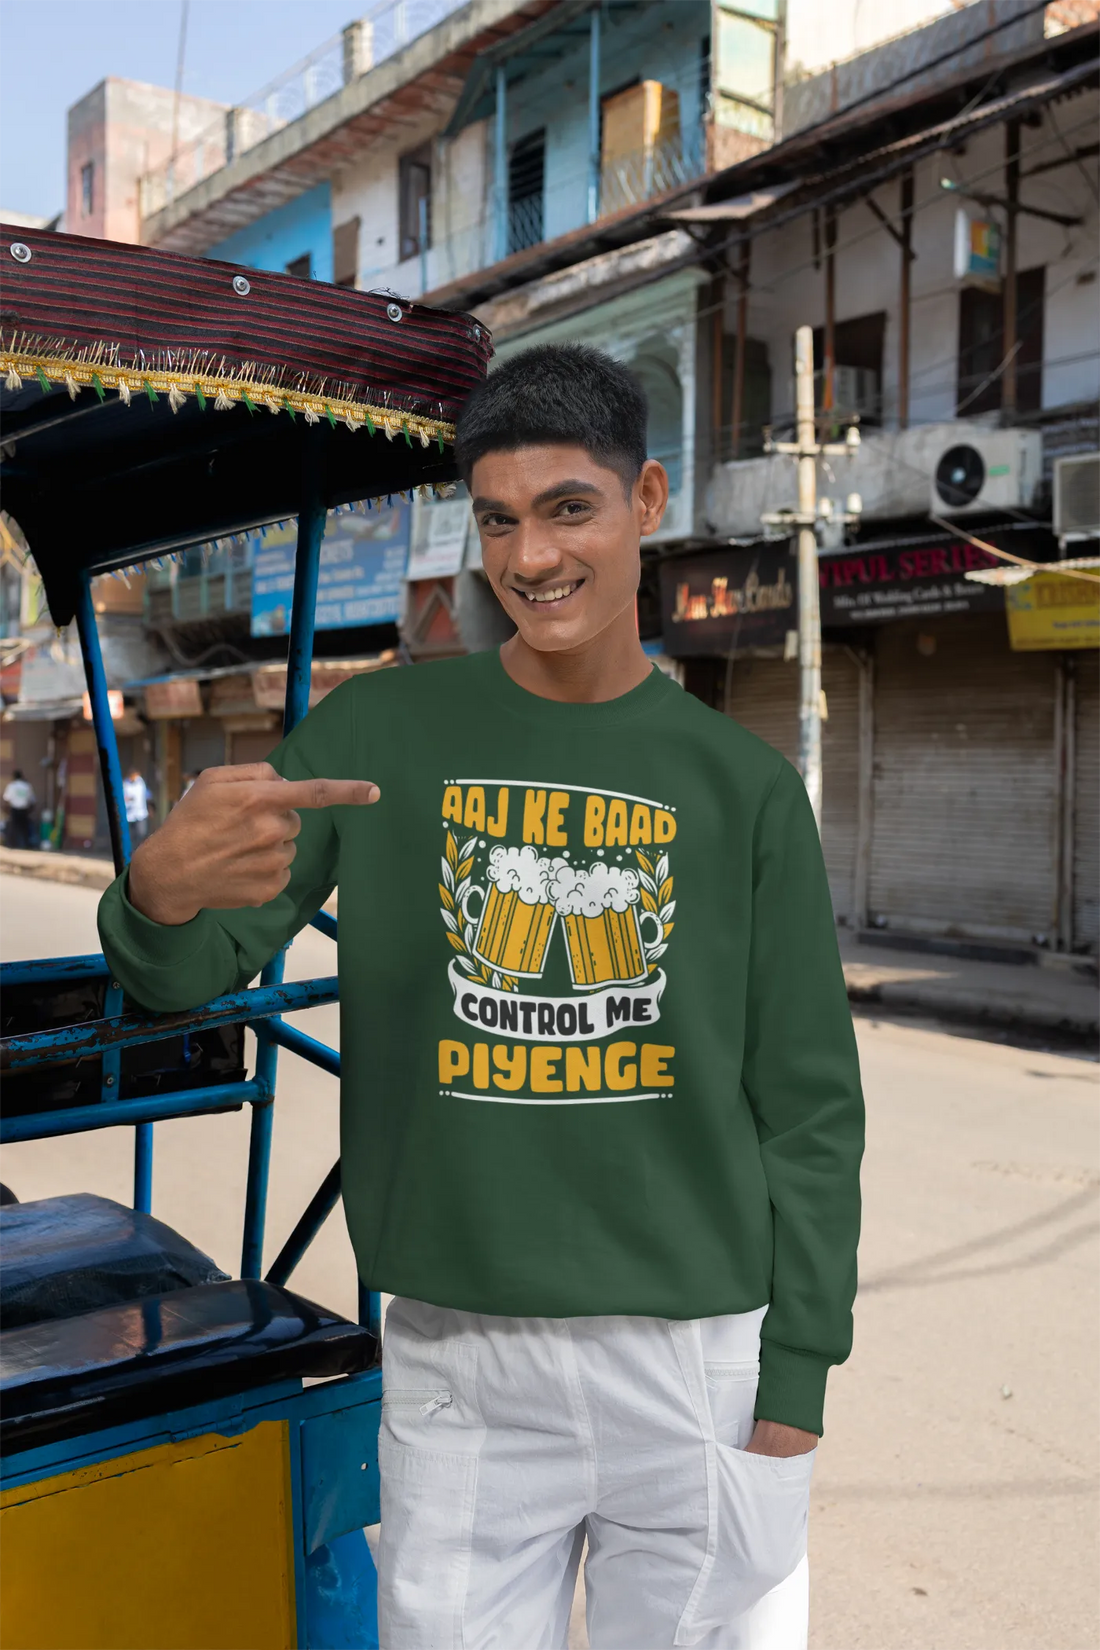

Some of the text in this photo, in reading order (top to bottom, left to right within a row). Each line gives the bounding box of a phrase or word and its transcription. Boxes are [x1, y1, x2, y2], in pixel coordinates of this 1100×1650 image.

[899, 541, 998, 579] SERIES
[442, 786, 677, 847] AAJ KE BAAD
[461, 992, 652, 1036] CONTROL ME
[438, 1039, 676, 1093] PIYENGE
